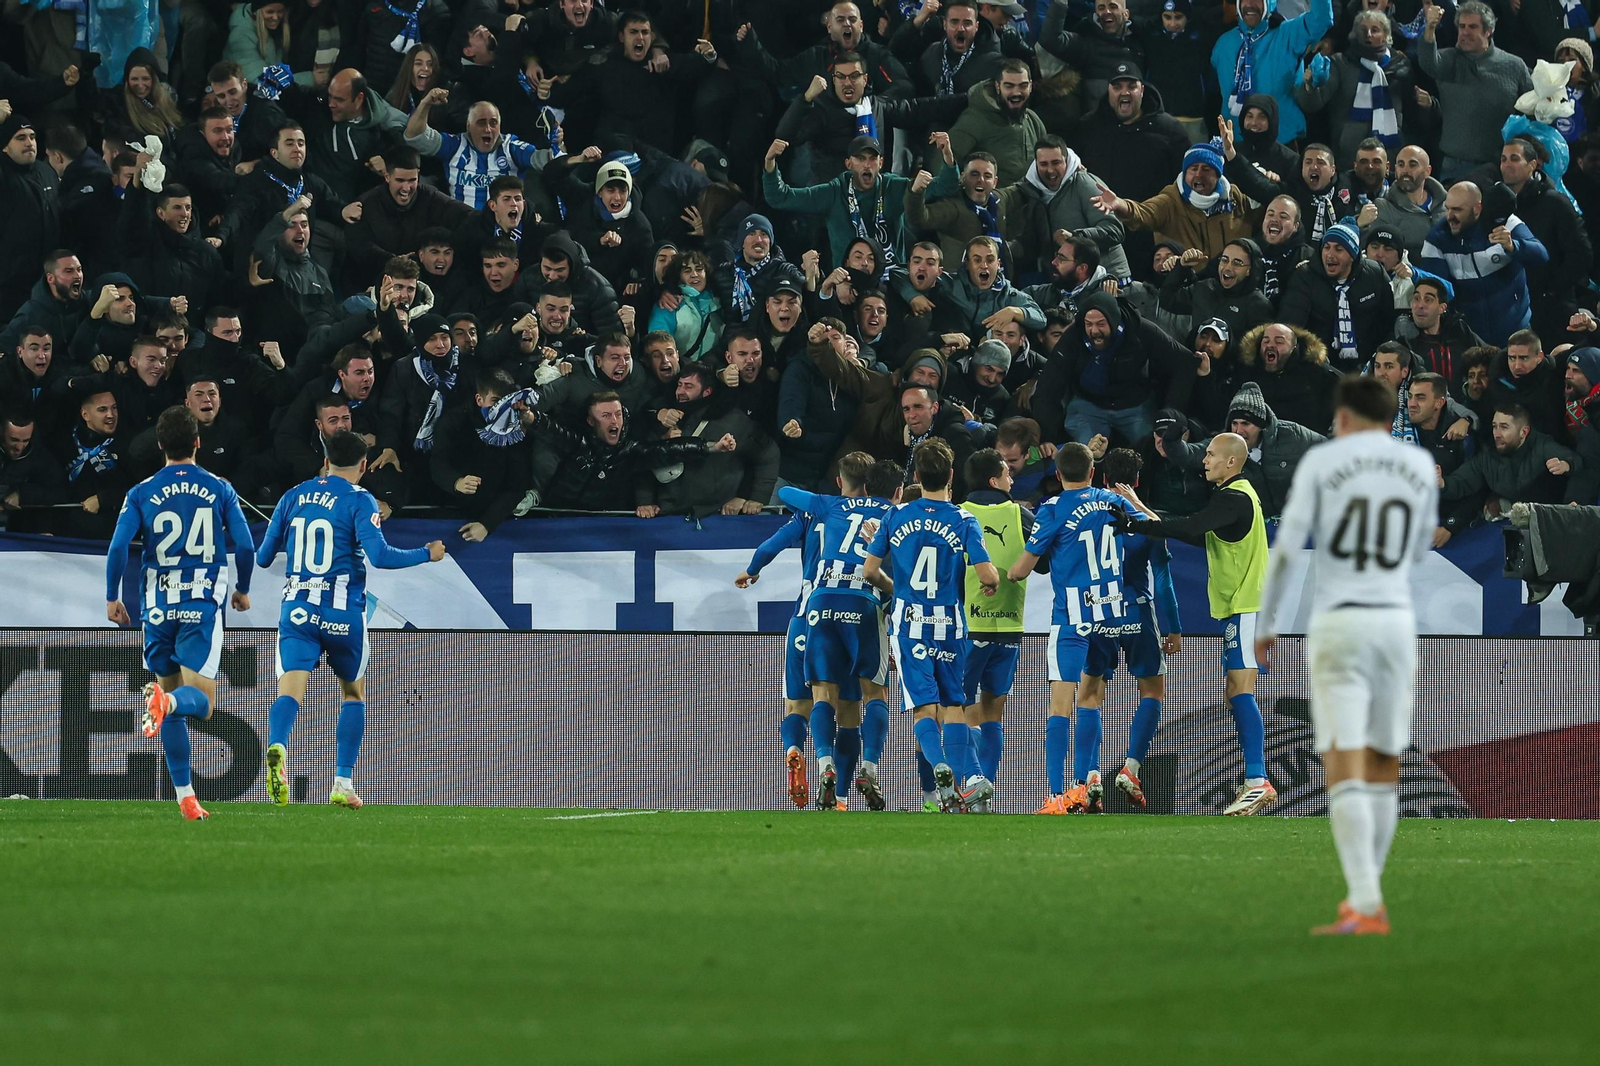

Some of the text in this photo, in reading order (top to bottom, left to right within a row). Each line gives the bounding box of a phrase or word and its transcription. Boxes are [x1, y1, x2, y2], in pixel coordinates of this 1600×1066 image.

[149, 482, 217, 506] V.PARADA
[298, 491, 338, 511] ALEÑÁ
[153, 507, 216, 567] 24
[290, 517, 334, 574] 10
[889, 518, 964, 554] DENIS SUÁREZ
[1329, 496, 1411, 571] 40
[1077, 524, 1120, 581] 14
[909, 546, 939, 599] 4
[320, 621, 350, 632] proex
[821, 609, 862, 621] El proex
[904, 604, 953, 625] Kutxabank
[928, 647, 938, 657] El
